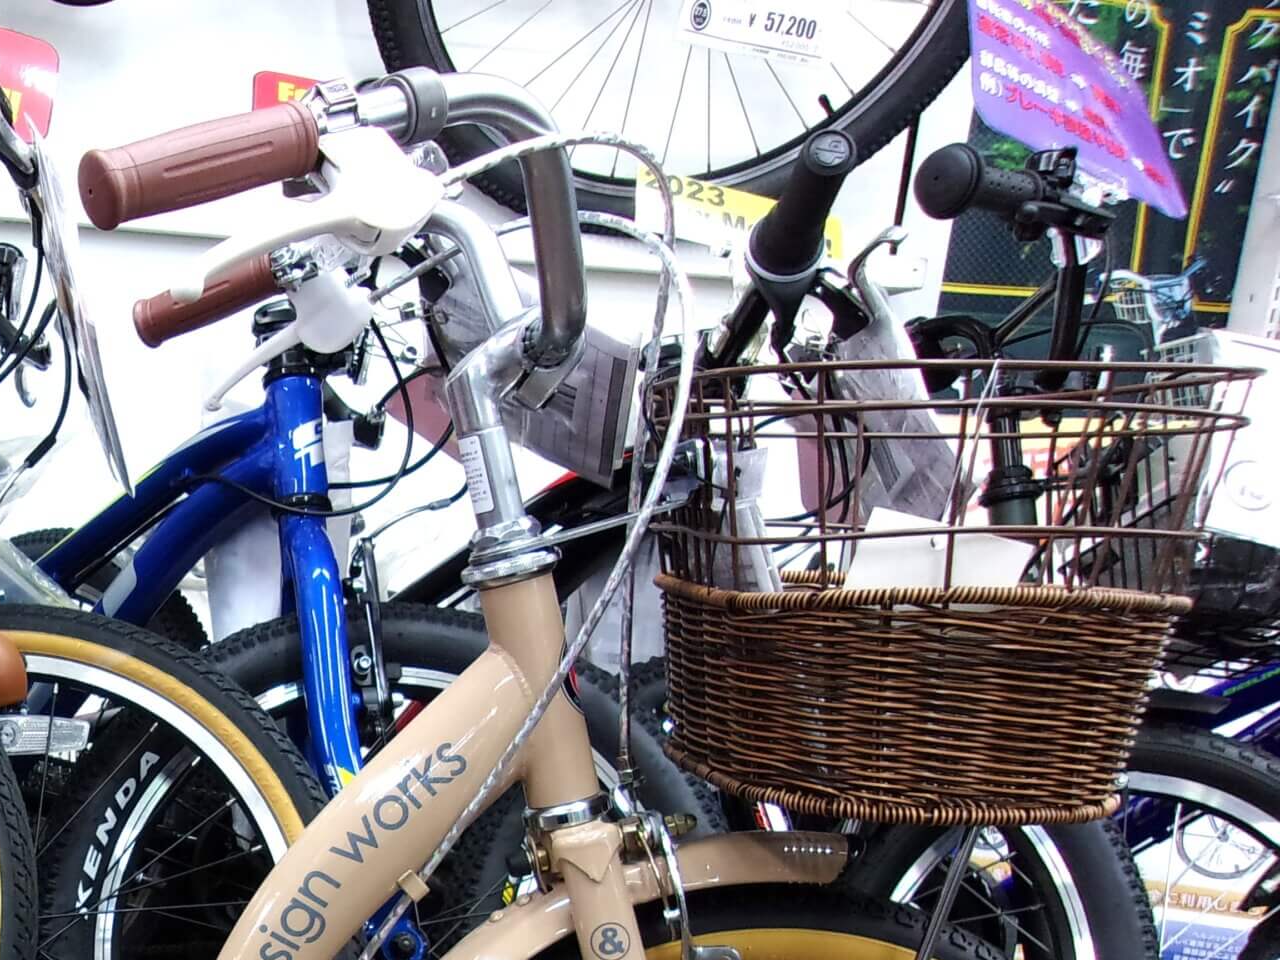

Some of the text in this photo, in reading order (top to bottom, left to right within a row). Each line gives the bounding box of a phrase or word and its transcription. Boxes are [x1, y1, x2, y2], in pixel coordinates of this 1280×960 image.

[764, 12, 818, 40] 57,200
[74, 751, 161, 921] KENDA
[328, 741, 469, 864] works
